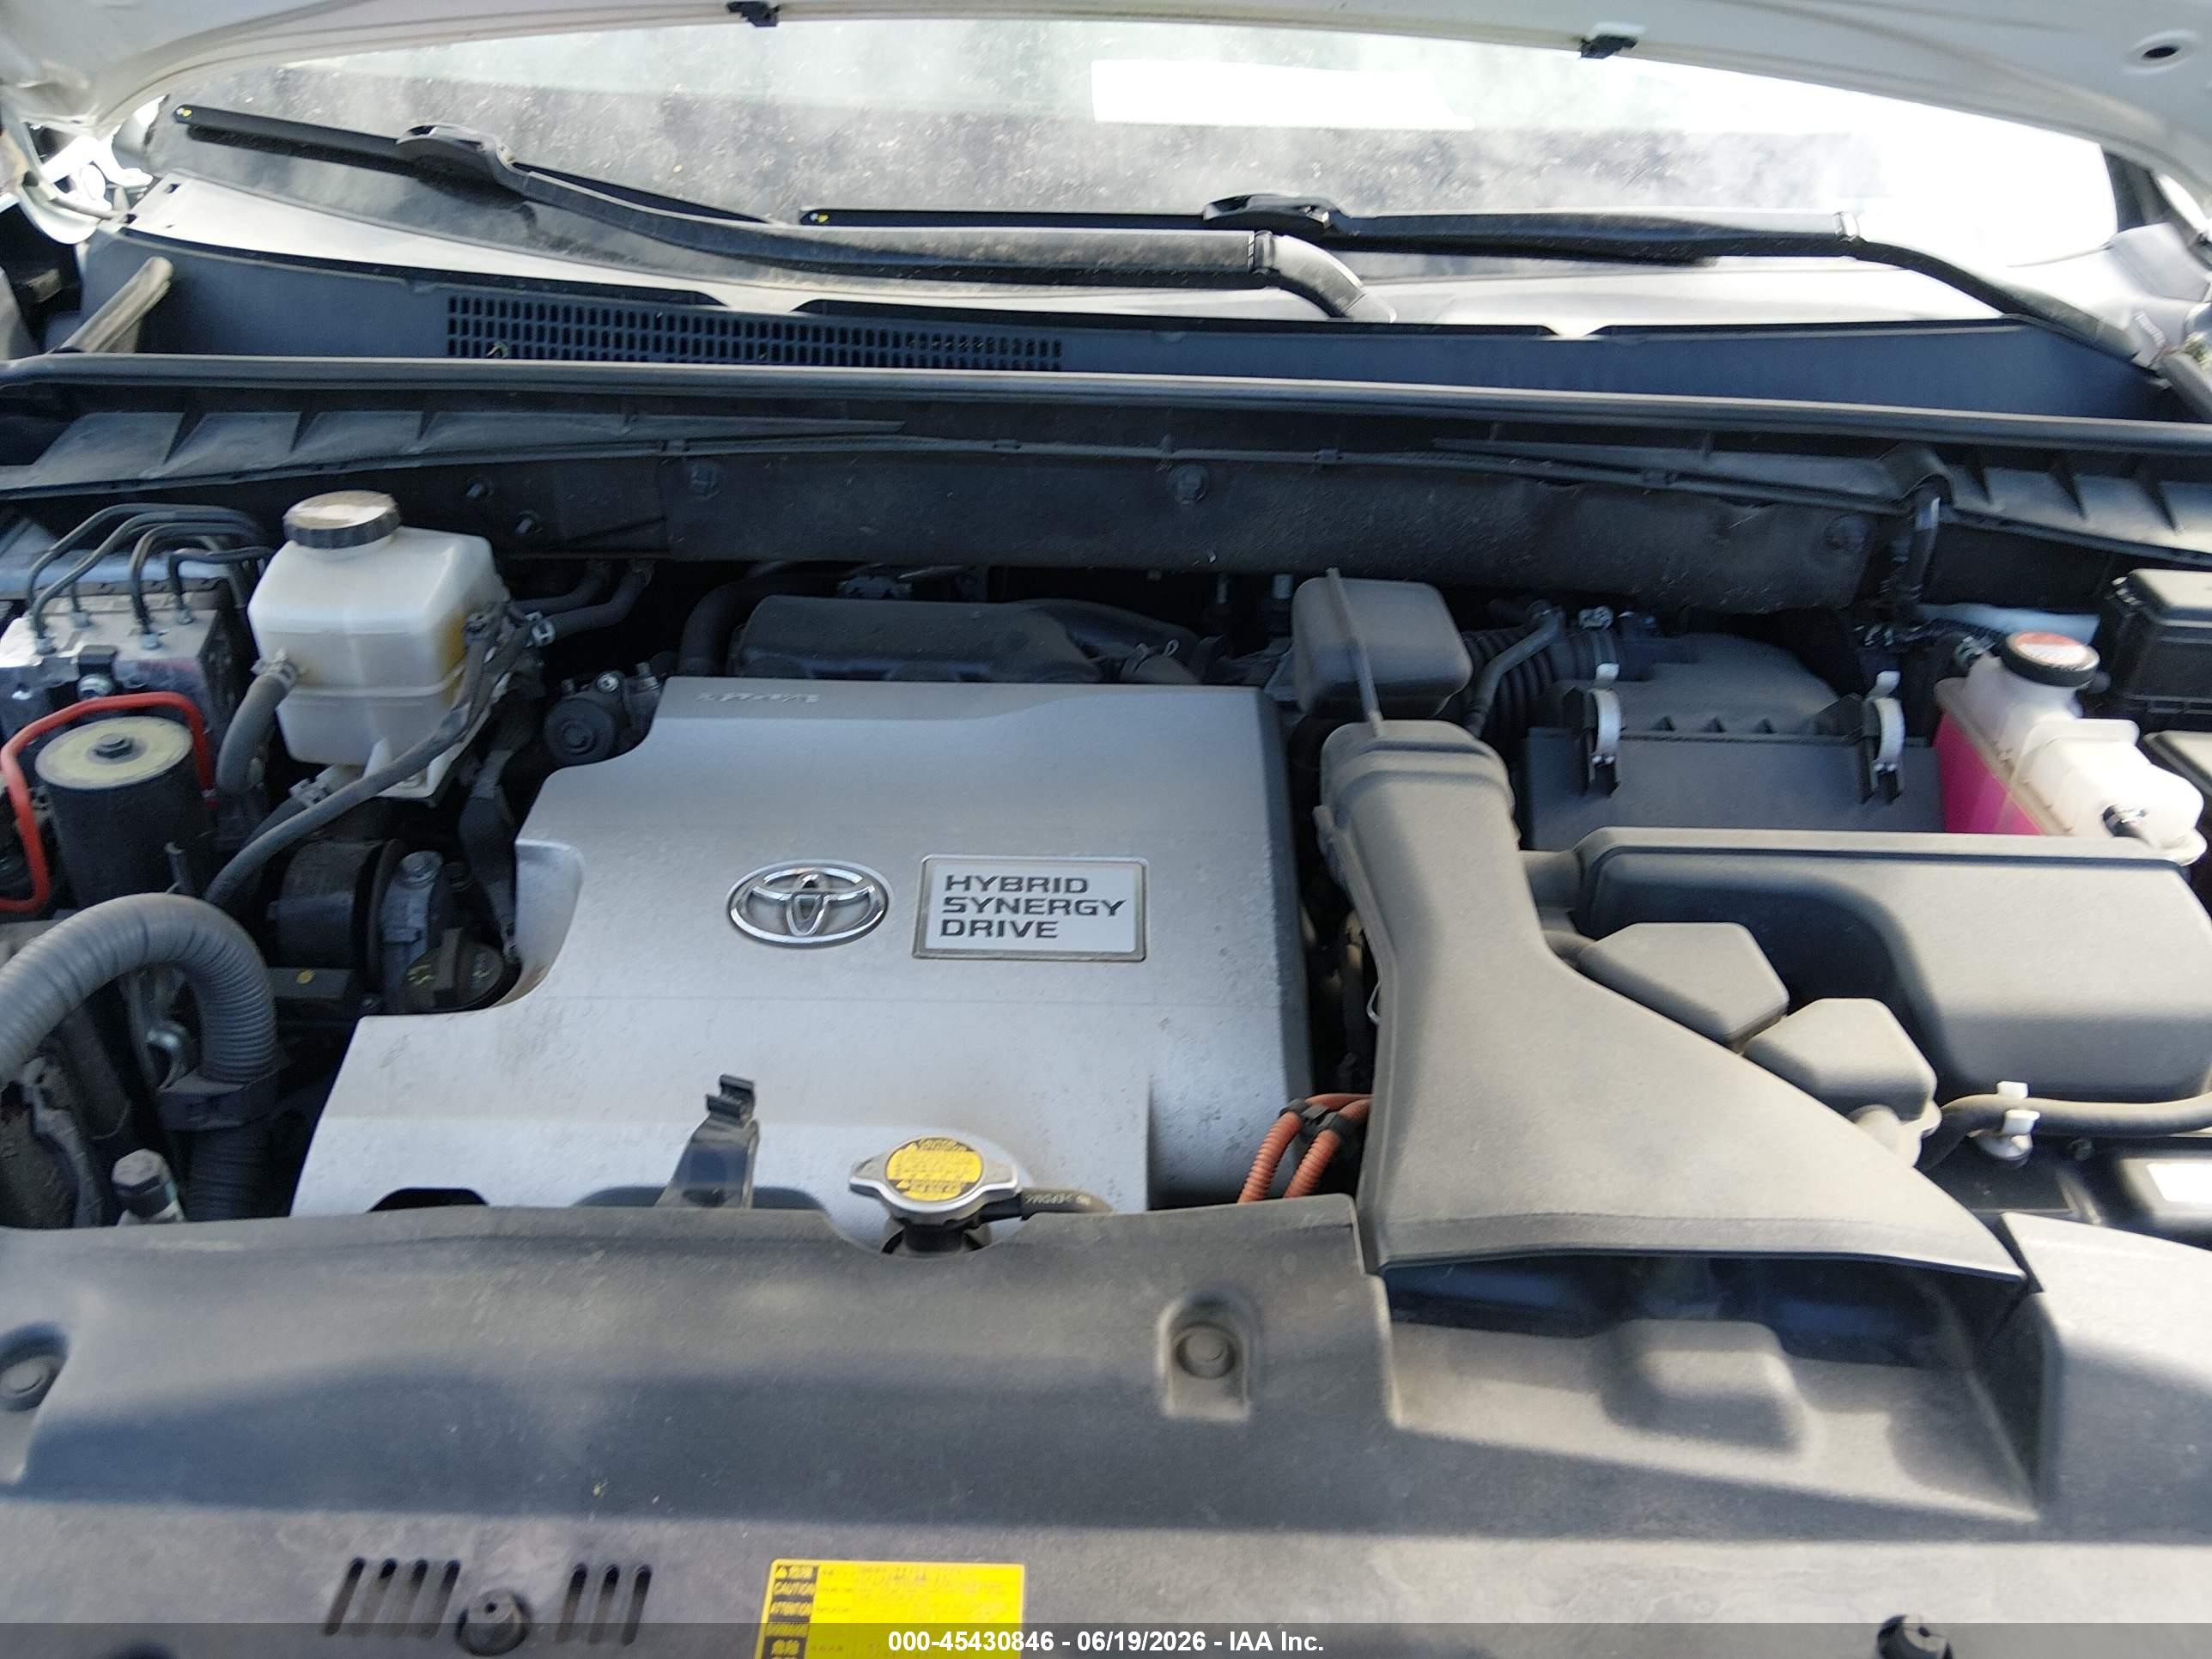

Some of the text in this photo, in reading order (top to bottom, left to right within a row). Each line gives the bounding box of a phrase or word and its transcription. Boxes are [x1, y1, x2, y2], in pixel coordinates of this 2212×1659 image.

[945, 875, 1089, 894] HYBRID
[943, 897, 1126, 916] SYNERGY
[940, 920, 1059, 938] DRIVE
